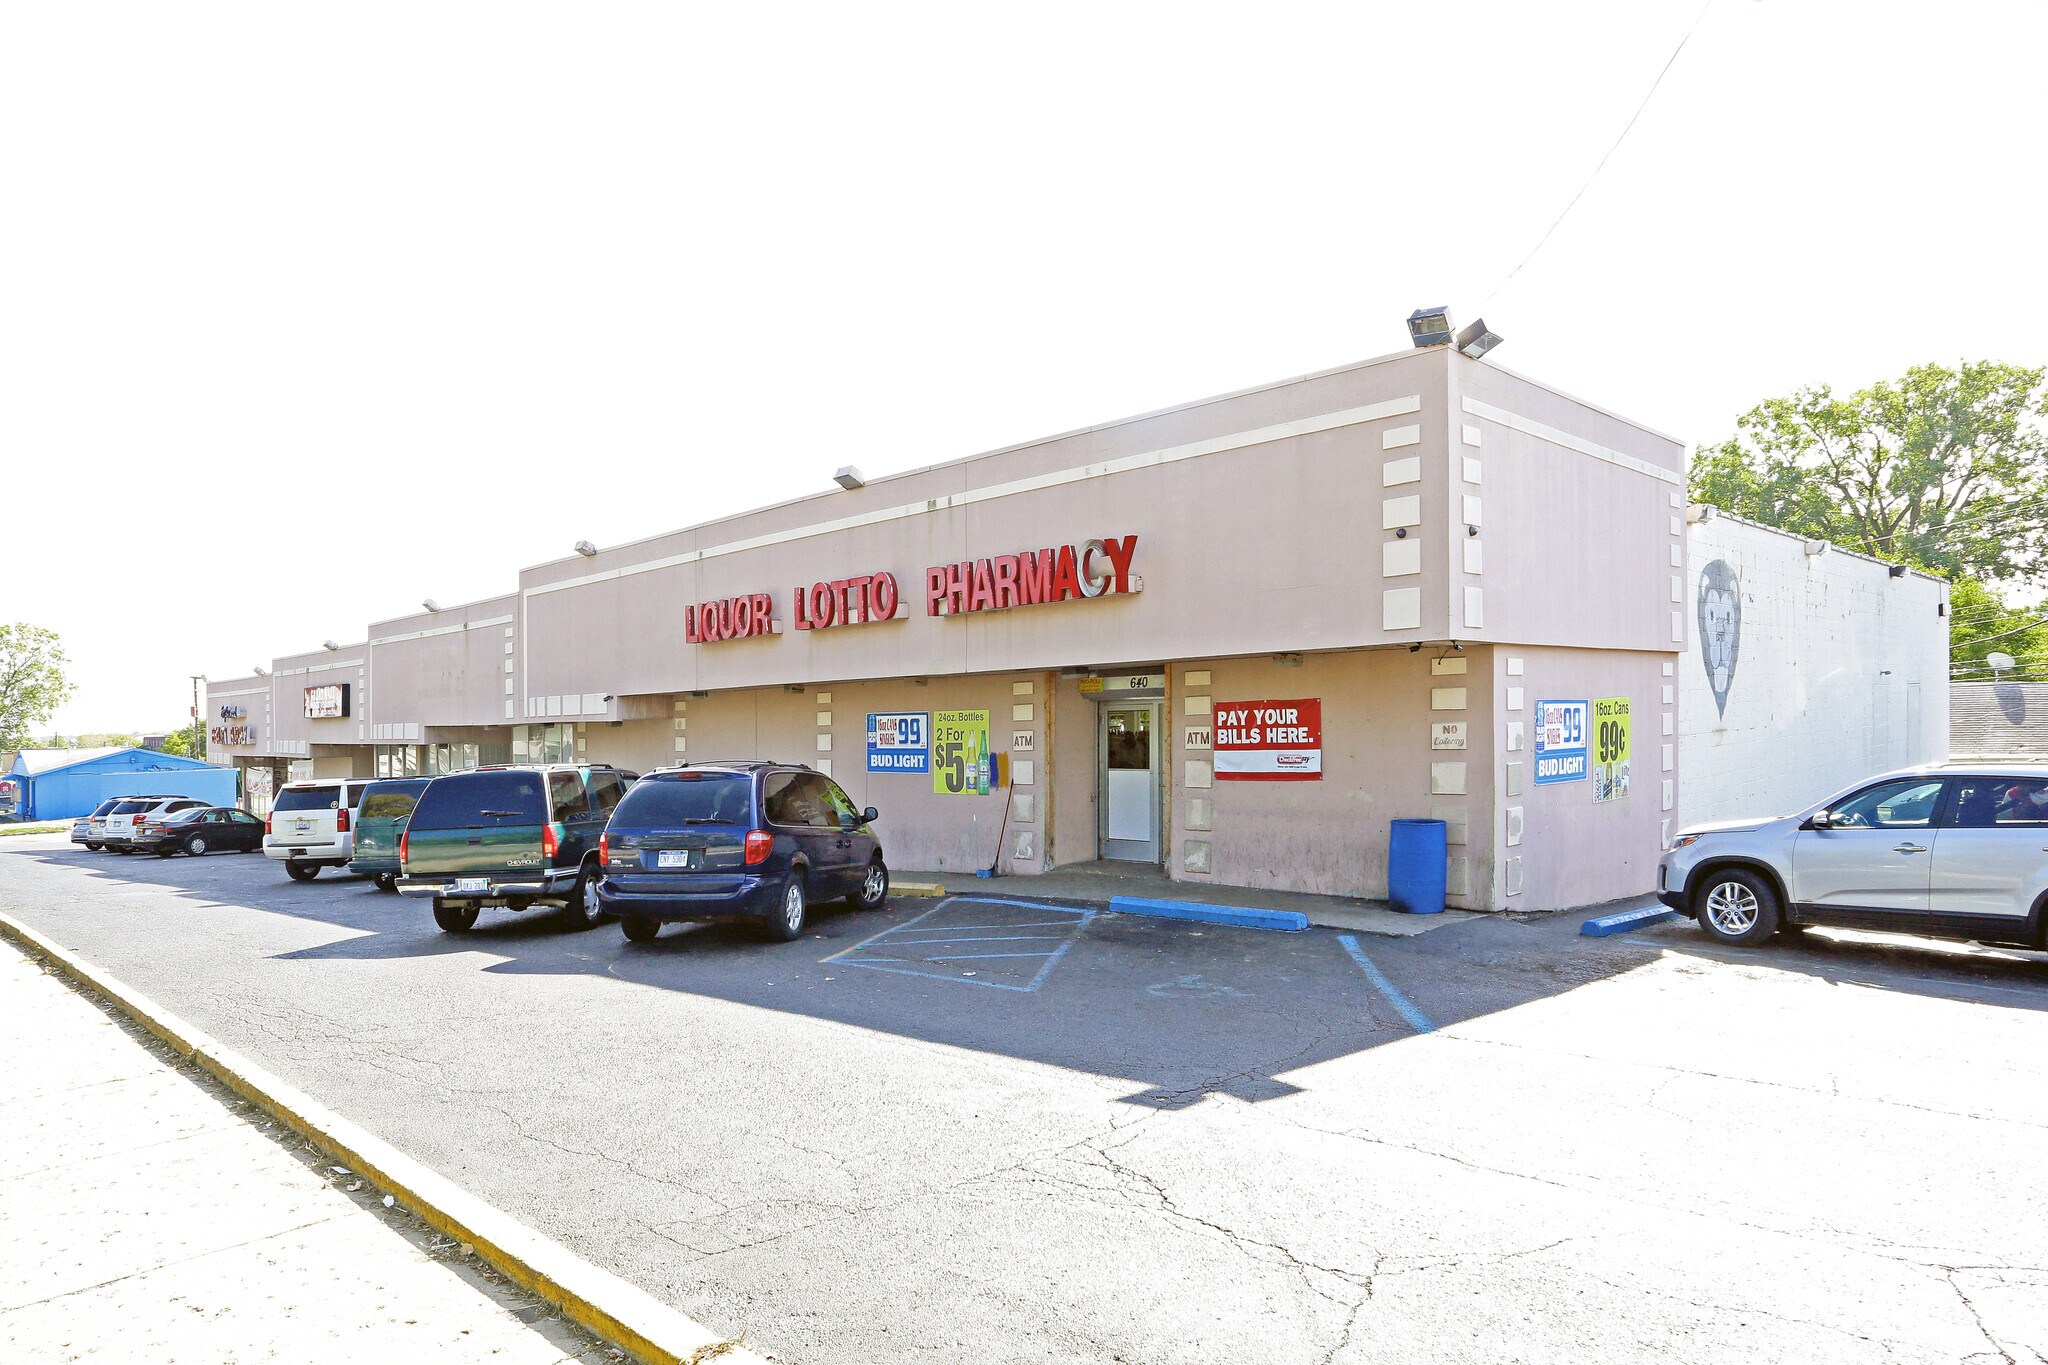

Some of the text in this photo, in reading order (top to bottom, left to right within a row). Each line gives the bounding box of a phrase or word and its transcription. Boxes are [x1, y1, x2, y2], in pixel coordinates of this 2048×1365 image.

[685, 534, 1139, 644] LIQUOR LOTTO PHARMACY
[1130, 676, 1148, 688] 640
[1595, 701, 1629, 716] 16oz. Cans
[938, 712, 984, 723] 24oz. Bottles
[1217, 708, 1298, 726] PAY YOUR
[898, 718, 921, 745] 99
[1443, 725, 1457, 734] NO
[1563, 707, 1581, 742] 99
[936, 727, 965, 741] 2 For
[1187, 731, 1210, 745] ATM
[1217, 726, 1314, 745] BILLS HERE.
[1013, 736, 1033, 747] ATM
[1434, 737, 1464, 746] Loitering
[870, 754, 925, 767] BUD LIGHT
[935, 742, 965, 793] $5
[1538, 756, 1584, 777] BUD LIGHT
